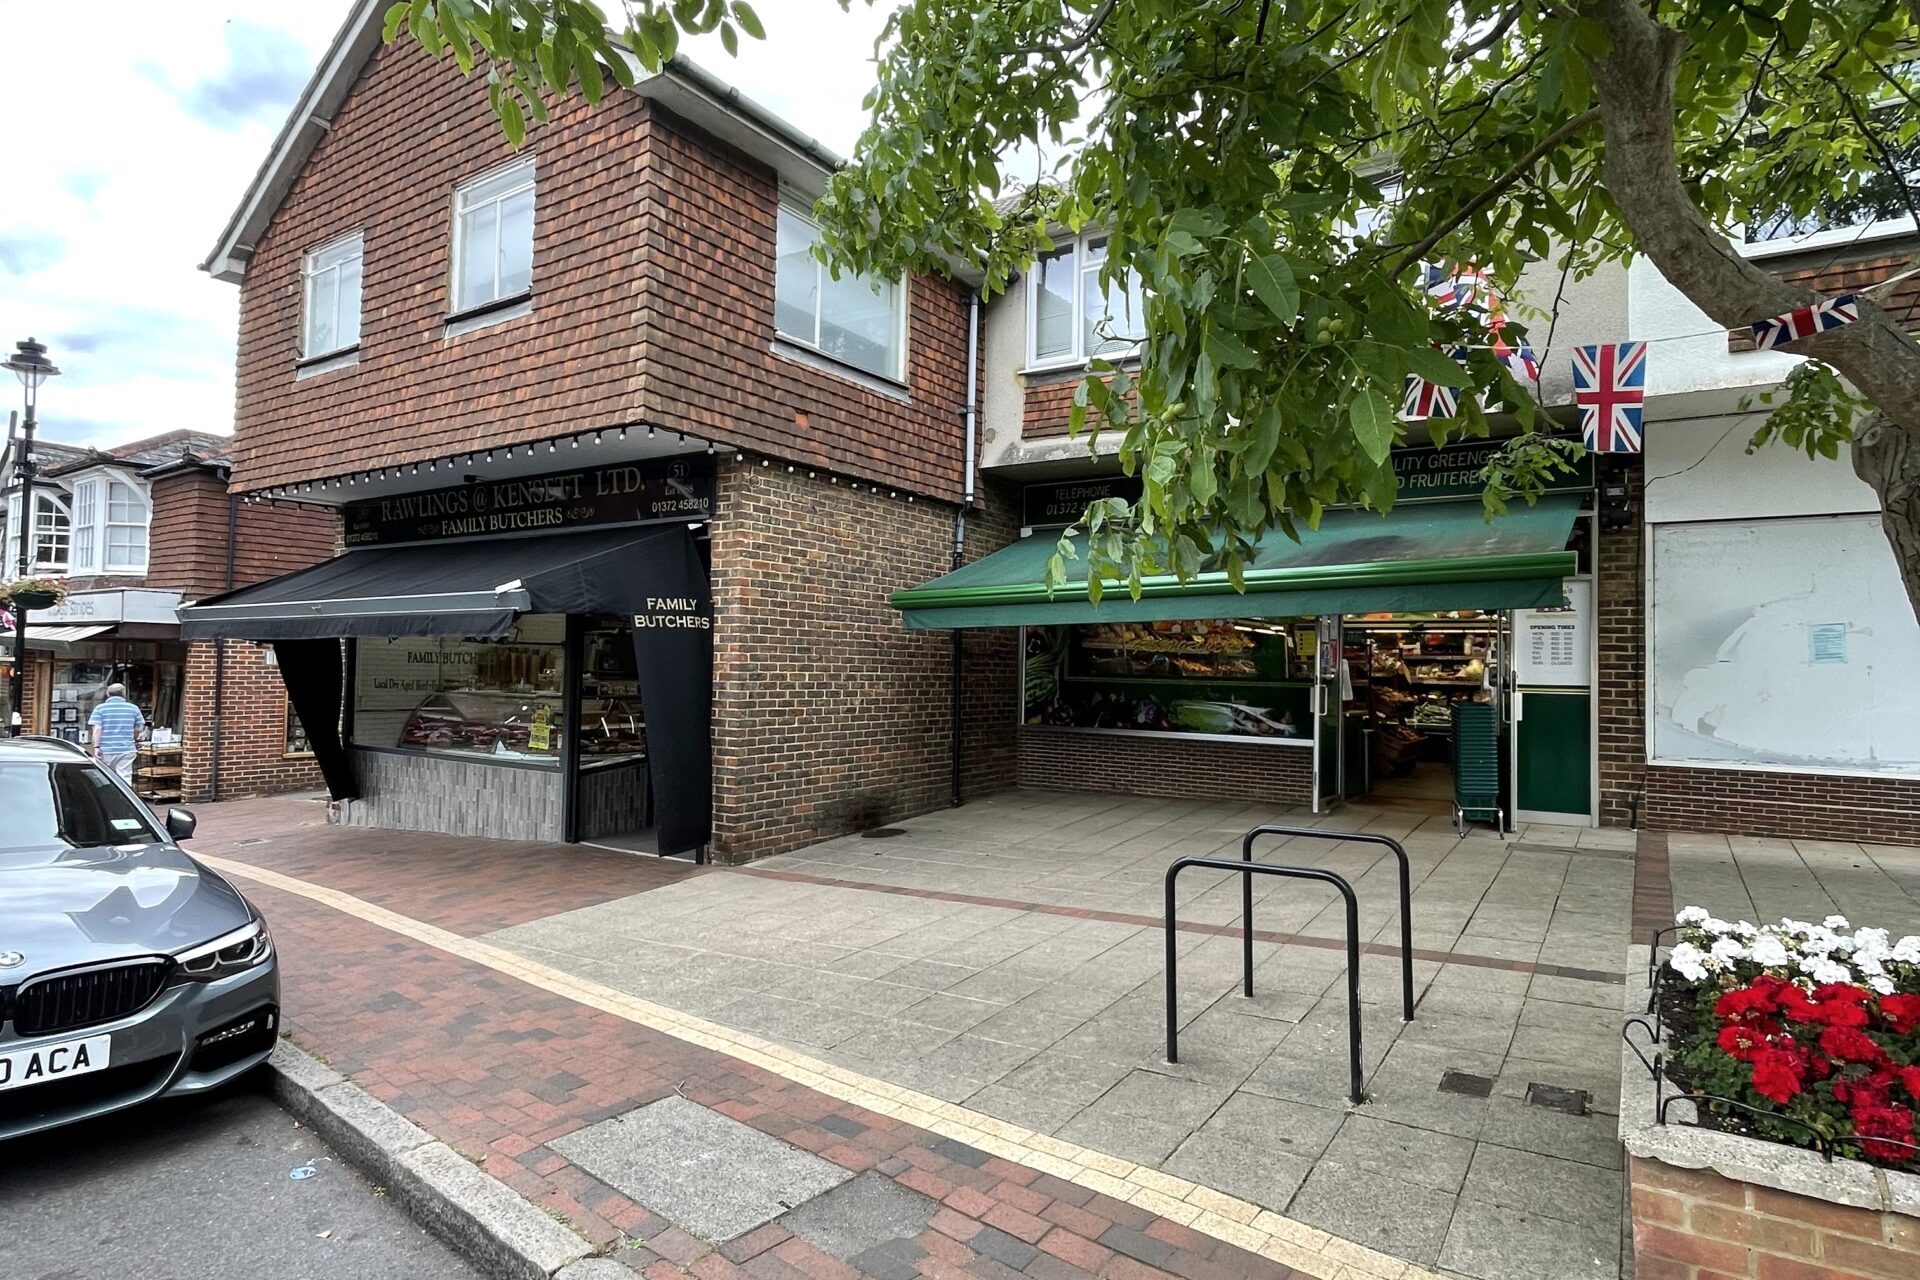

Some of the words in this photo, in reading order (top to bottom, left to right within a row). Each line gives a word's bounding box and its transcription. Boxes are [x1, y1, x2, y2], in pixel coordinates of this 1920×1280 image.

[674, 464, 684, 477] 51
[381, 490, 468, 521] RAWLINGS
[493, 474, 584, 509] KENSETT
[596, 467, 646, 496] LTD.
[1055, 484, 1111, 500] TELEPHONE
[652, 500, 677, 513] 01372
[678, 497, 709, 510] 458210
[1046, 502, 1077, 515] 01372
[442, 516, 487, 536] FAMILY
[489, 507, 563, 530] BUTCHERS
[646, 597, 698, 611] FAMILY
[634, 614, 710, 630] BUTCHERS
[407, 651, 440, 664] FAMILY
[24, 1043, 90, 1080] ACA
